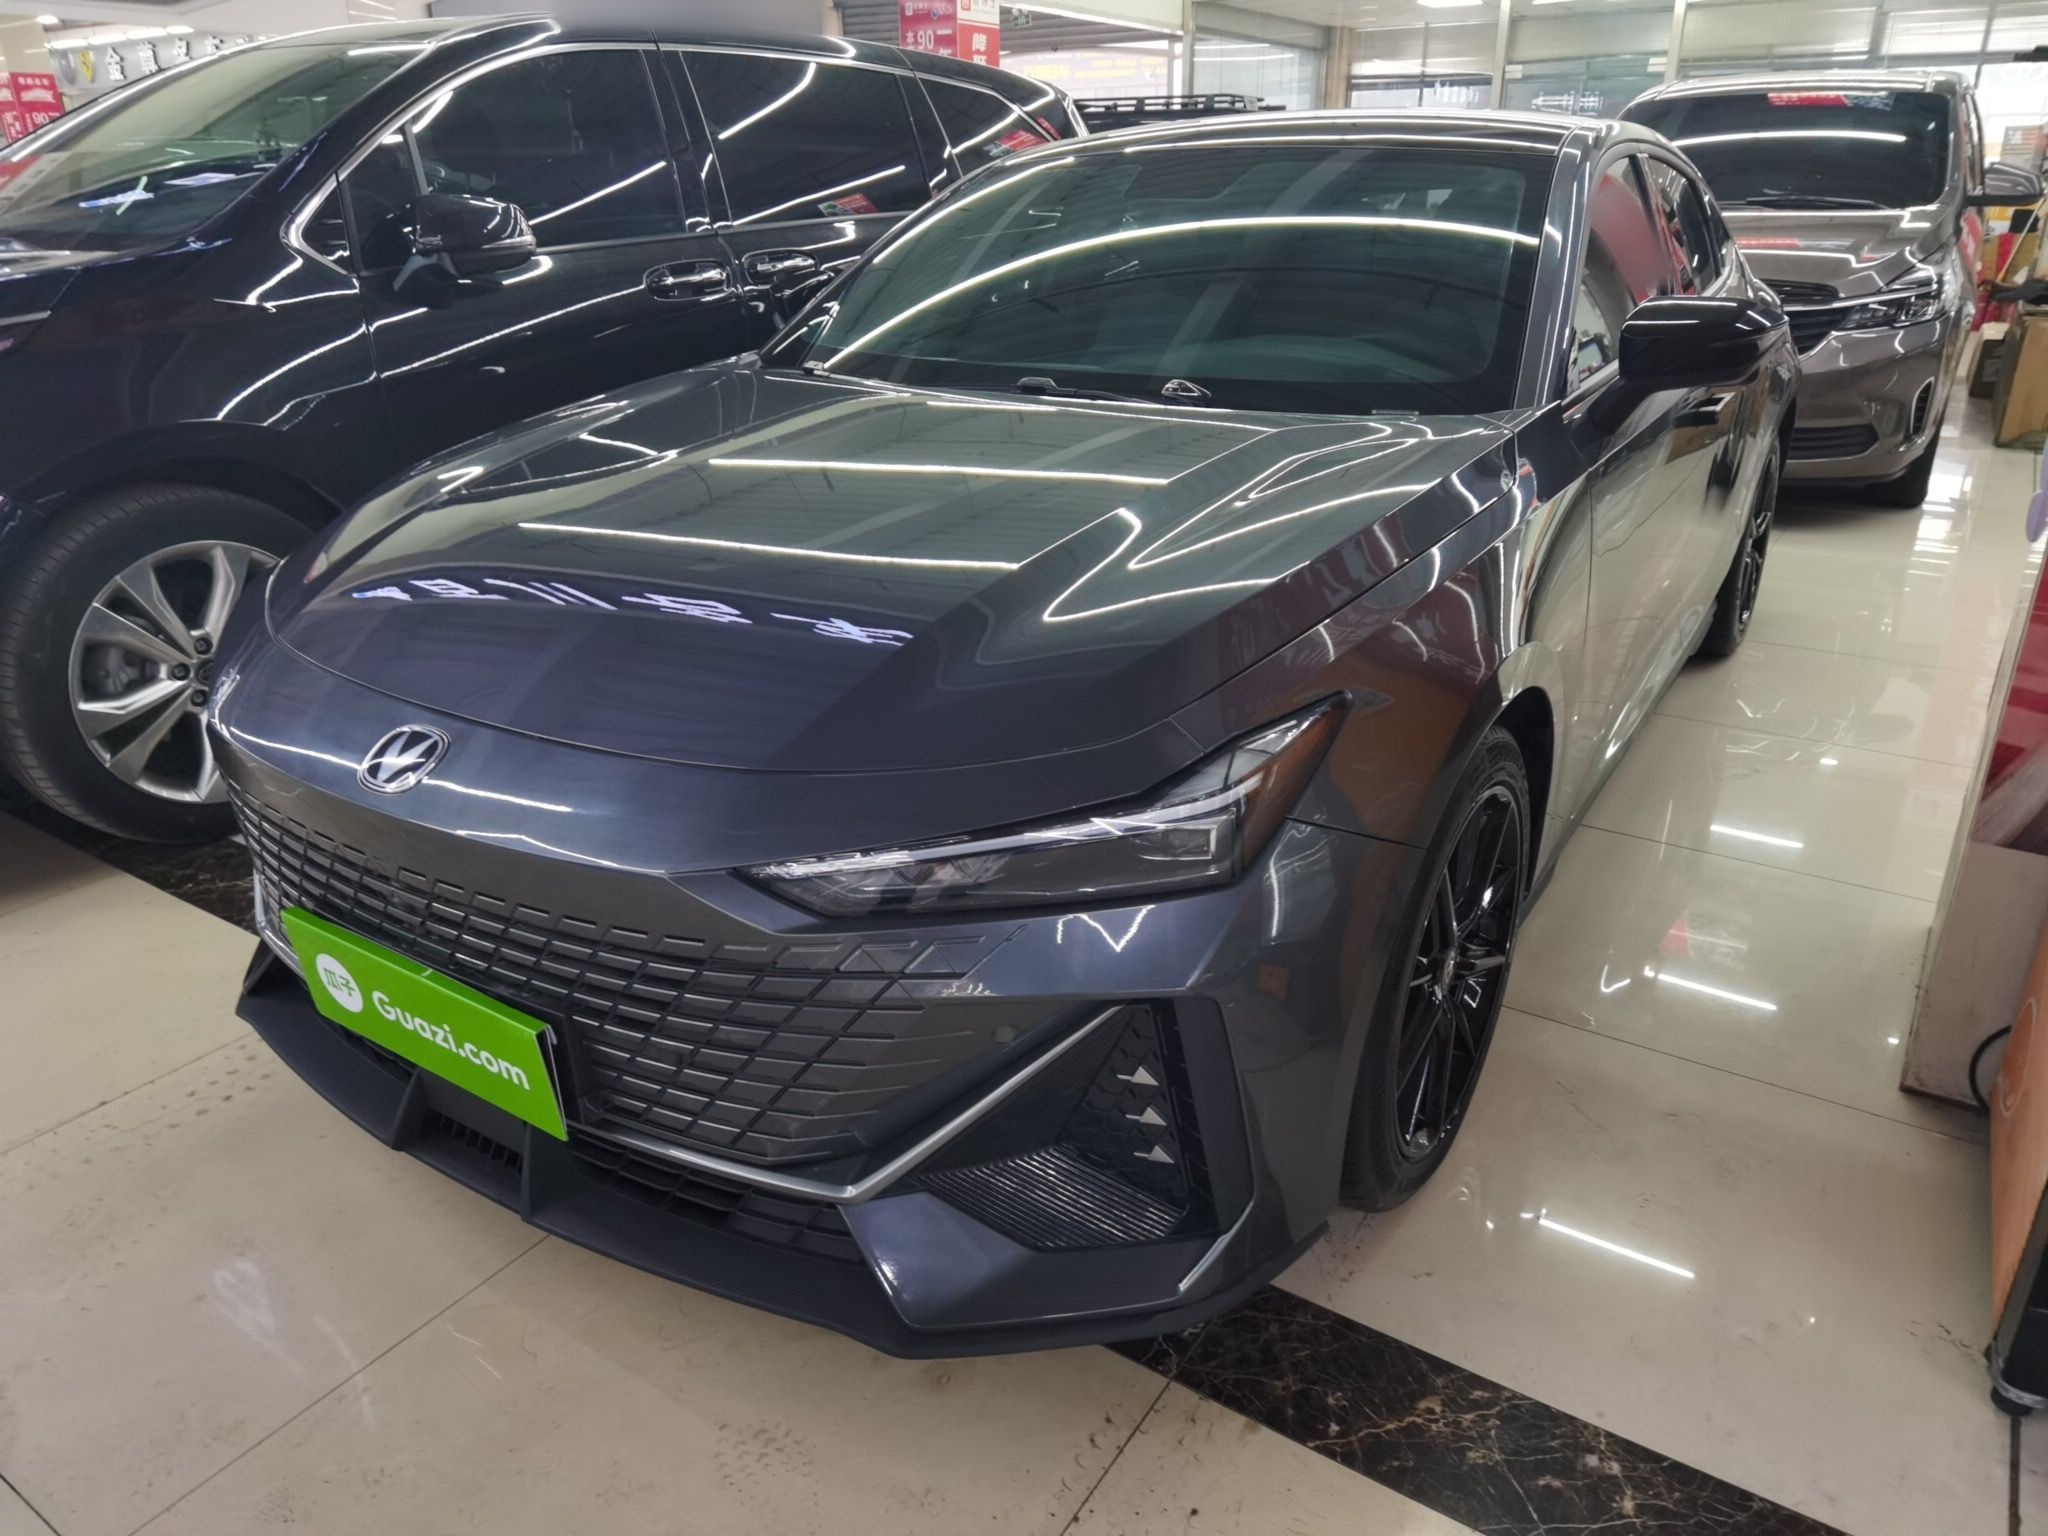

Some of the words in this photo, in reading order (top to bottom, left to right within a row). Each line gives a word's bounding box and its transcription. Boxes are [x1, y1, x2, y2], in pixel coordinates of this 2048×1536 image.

[918, 30, 934, 50] 90
[323, 967, 356, 998] 瓜子
[372, 990, 531, 1091] Guazi.com
